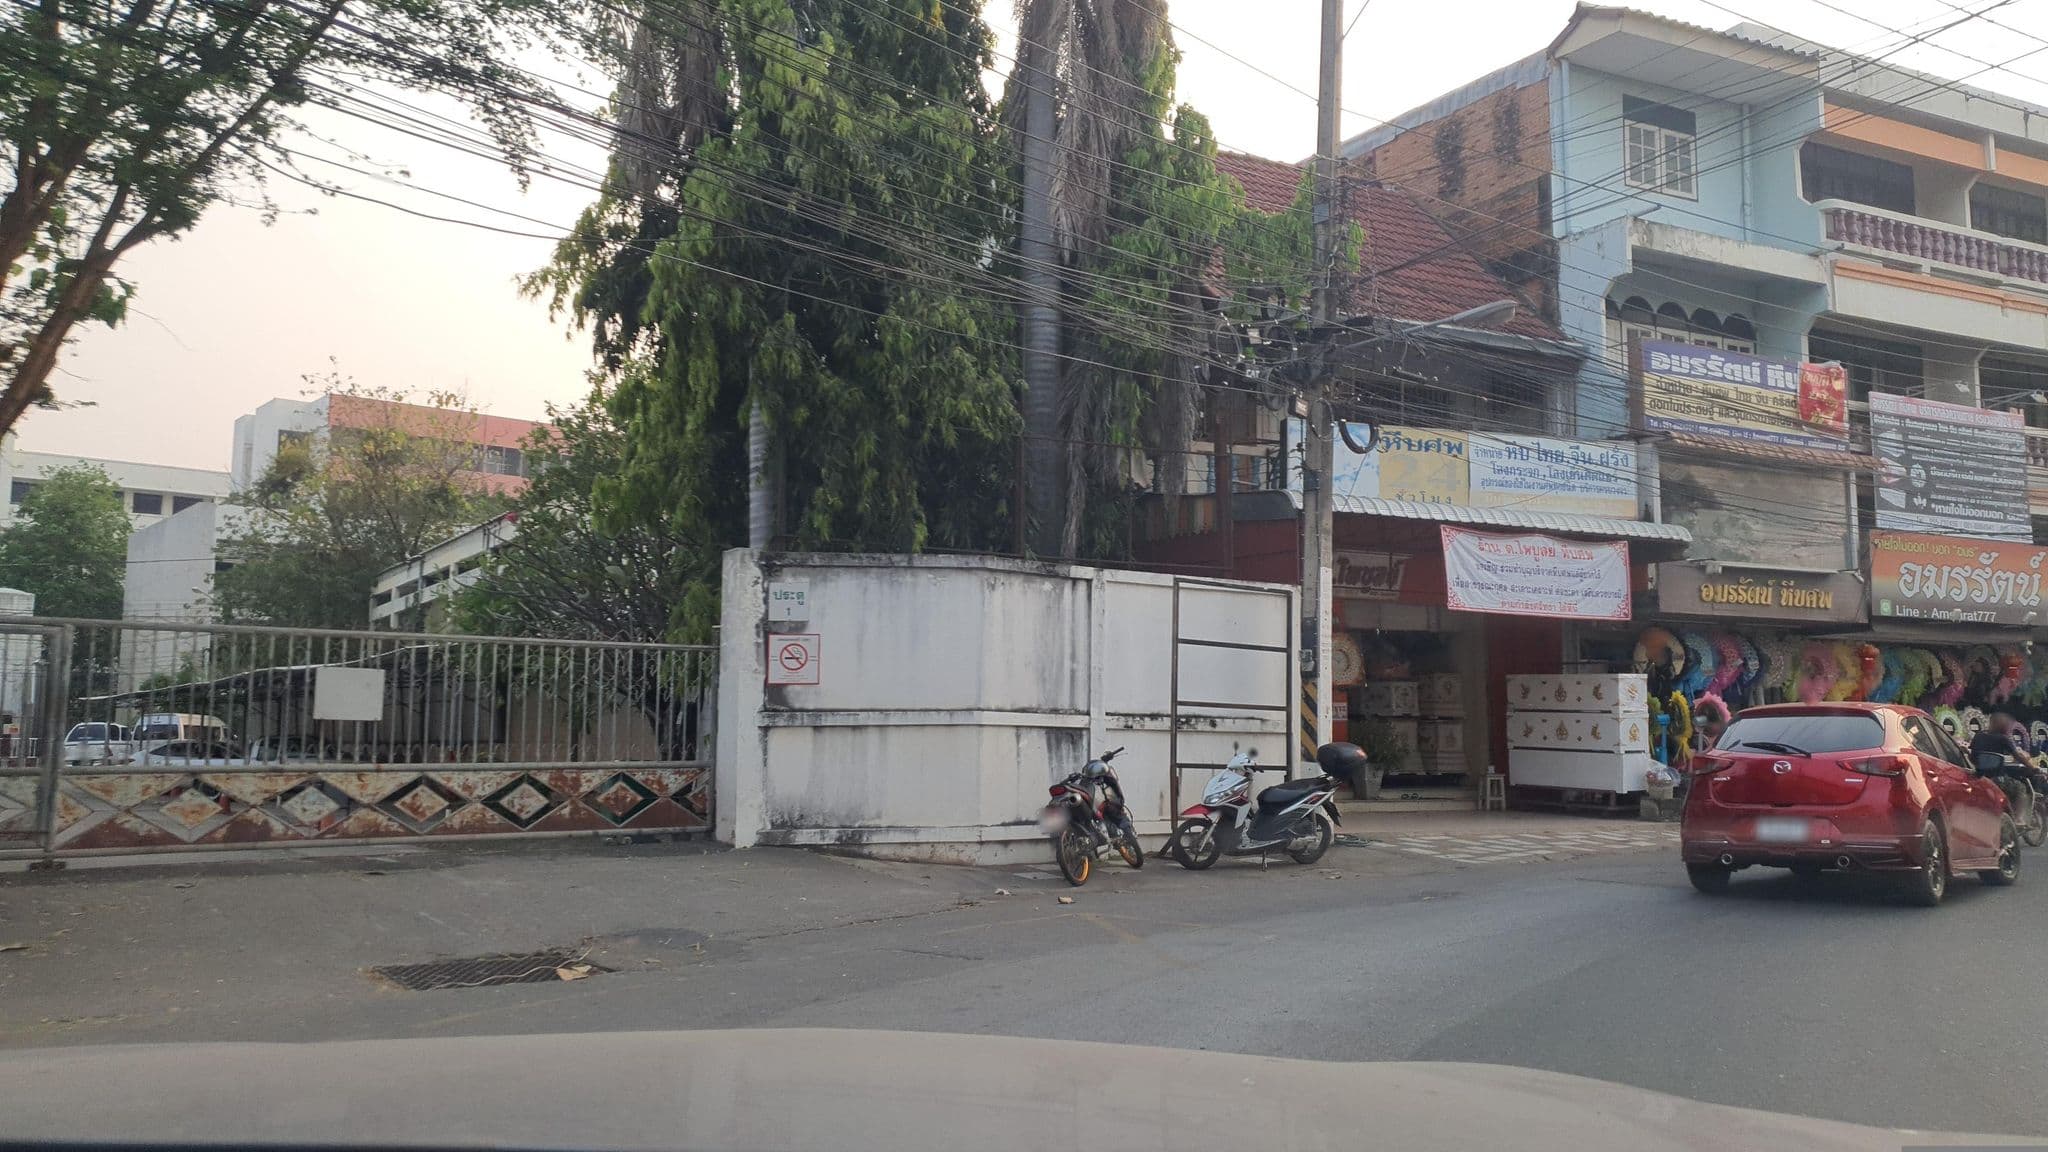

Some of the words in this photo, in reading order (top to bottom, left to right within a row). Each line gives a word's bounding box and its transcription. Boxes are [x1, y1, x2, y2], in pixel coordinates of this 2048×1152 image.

[1650, 351, 1761, 385] อมรรัตน์
[1767, 363, 1798, 390] หีบ
[1701, 576, 1775, 605] อมรรัตน์
[1780, 580, 1833, 609] หีบศพ
[1899, 551, 2047, 607] อมรรัตน์
[773, 590, 805, 606] ประตู
[1896, 605, 1920, 617] Line
[1931, 607, 1997, 622] Amrat777
